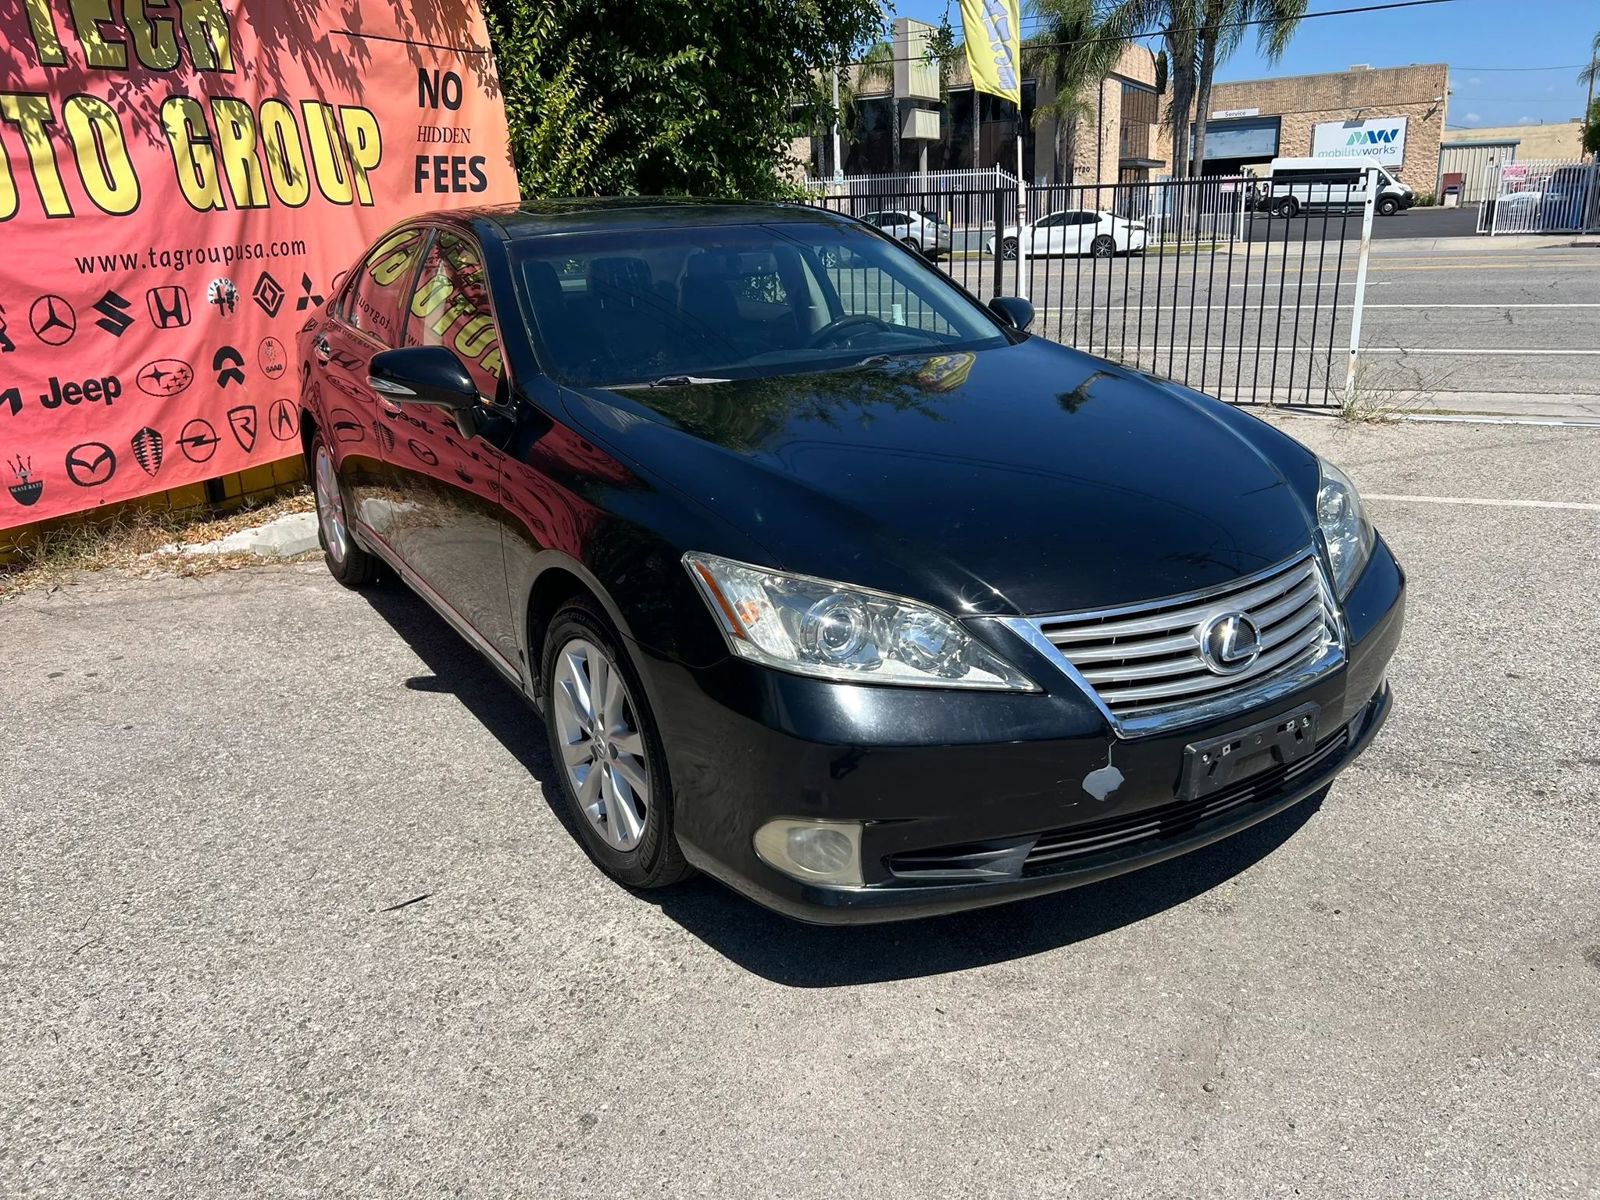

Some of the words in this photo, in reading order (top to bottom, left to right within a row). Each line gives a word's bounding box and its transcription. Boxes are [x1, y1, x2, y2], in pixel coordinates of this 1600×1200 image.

[418, 67, 463, 111] NO
[416, 125, 471, 143] HIDDEN
[1318, 145, 1396, 158] mobilityworks
[160, 94, 382, 213] GROUP
[414, 155, 488, 193] FEES
[75, 239, 307, 275] www.tagroupusa.com
[40, 375, 122, 409] Jeep
